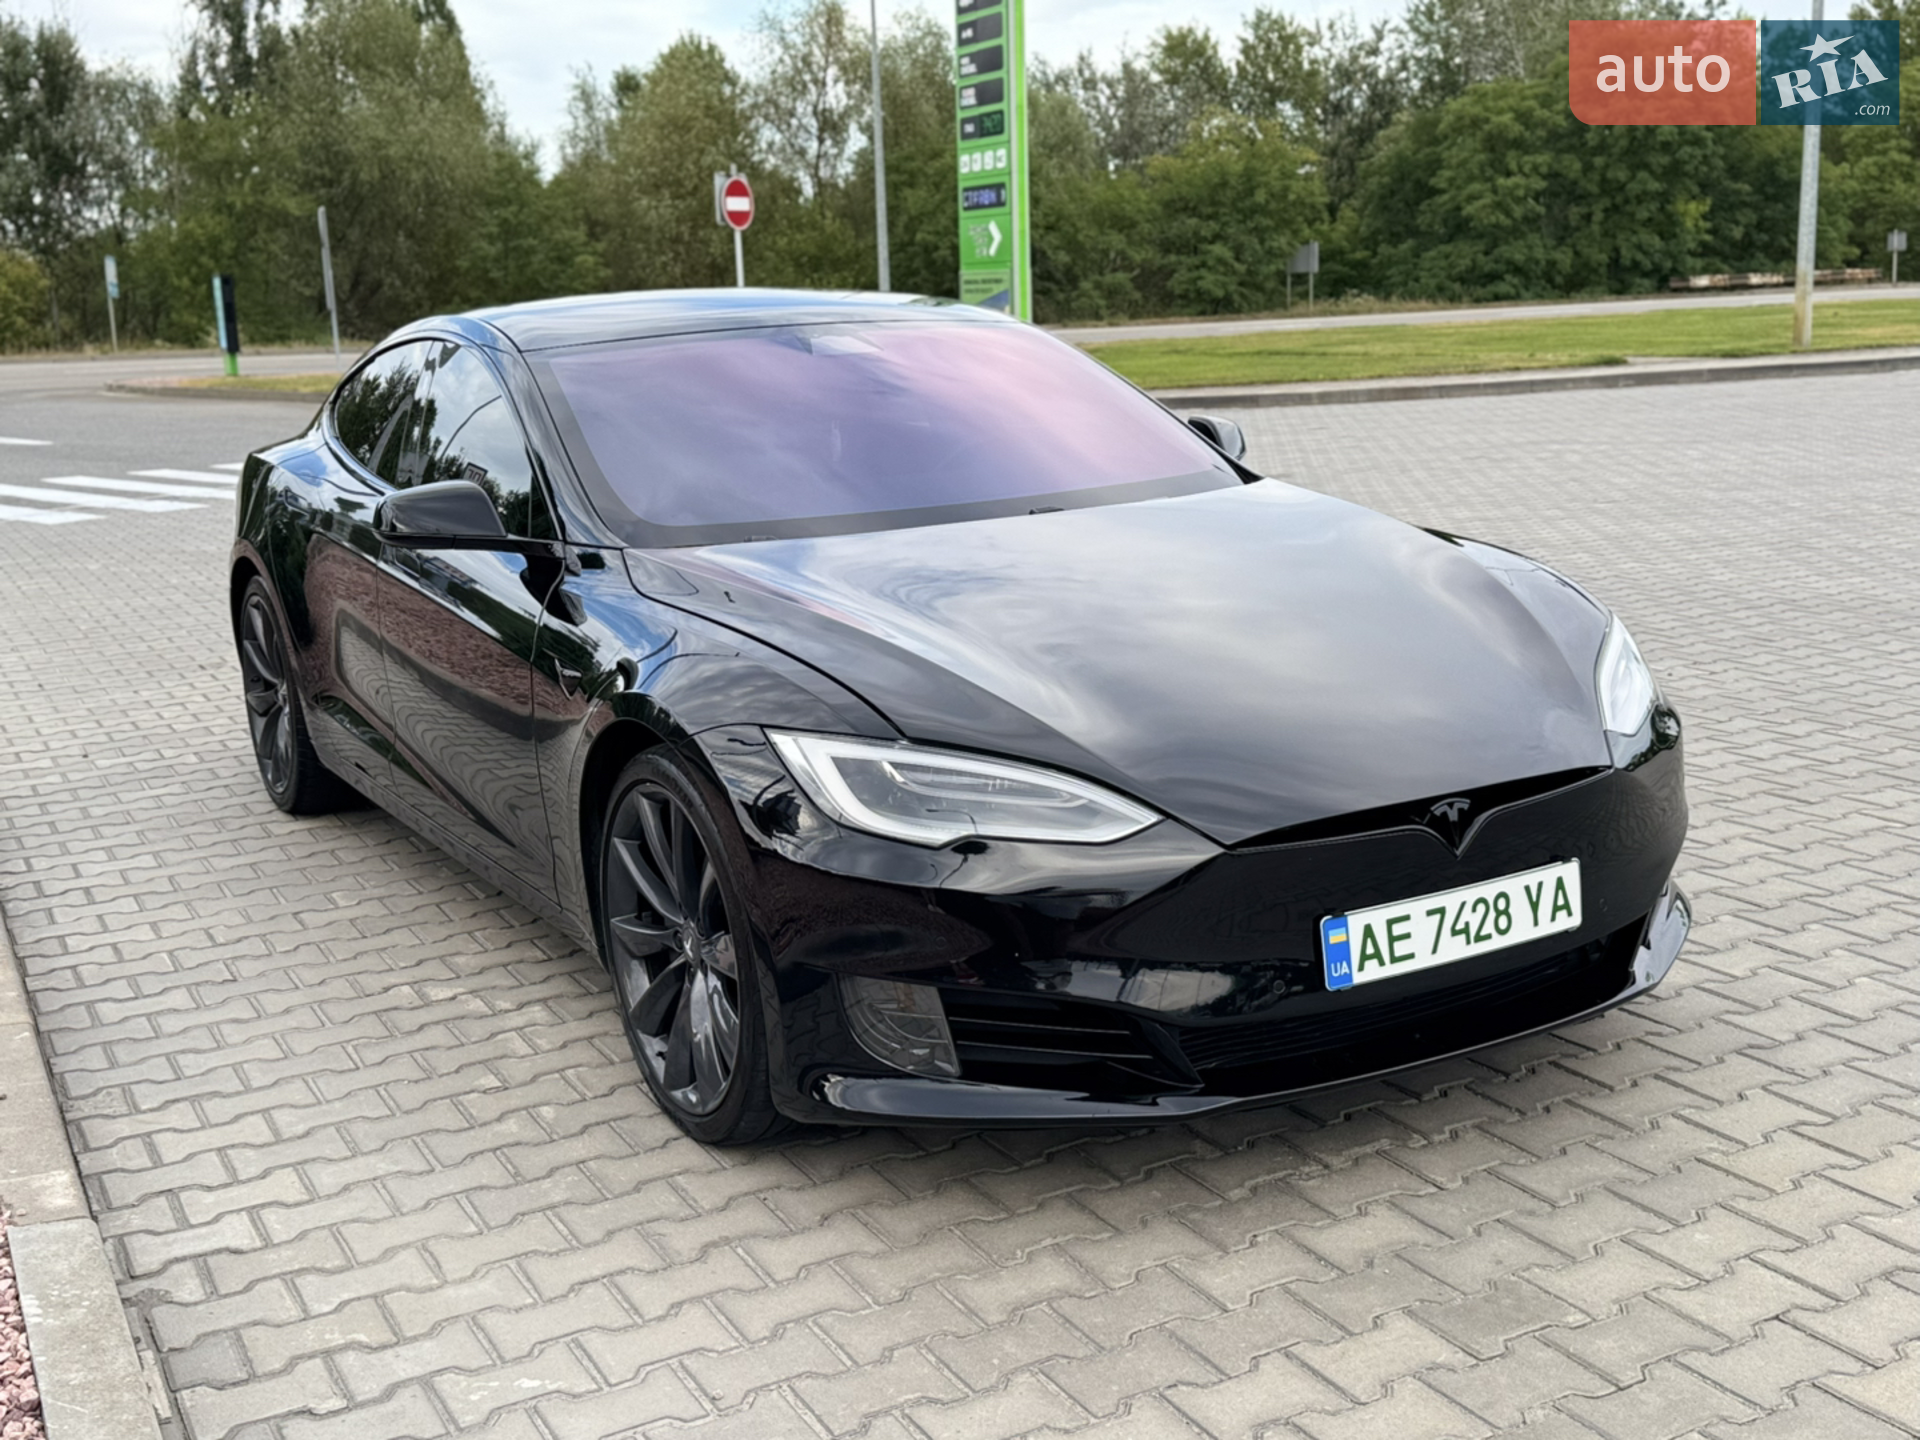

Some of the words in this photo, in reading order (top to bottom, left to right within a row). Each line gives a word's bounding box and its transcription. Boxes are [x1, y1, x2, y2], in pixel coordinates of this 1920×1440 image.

[1357, 914, 1416, 973] AE
[1426, 891, 1513, 956] 7428
[1524, 876, 1573, 928] YA
[1331, 961, 1350, 977] UA
